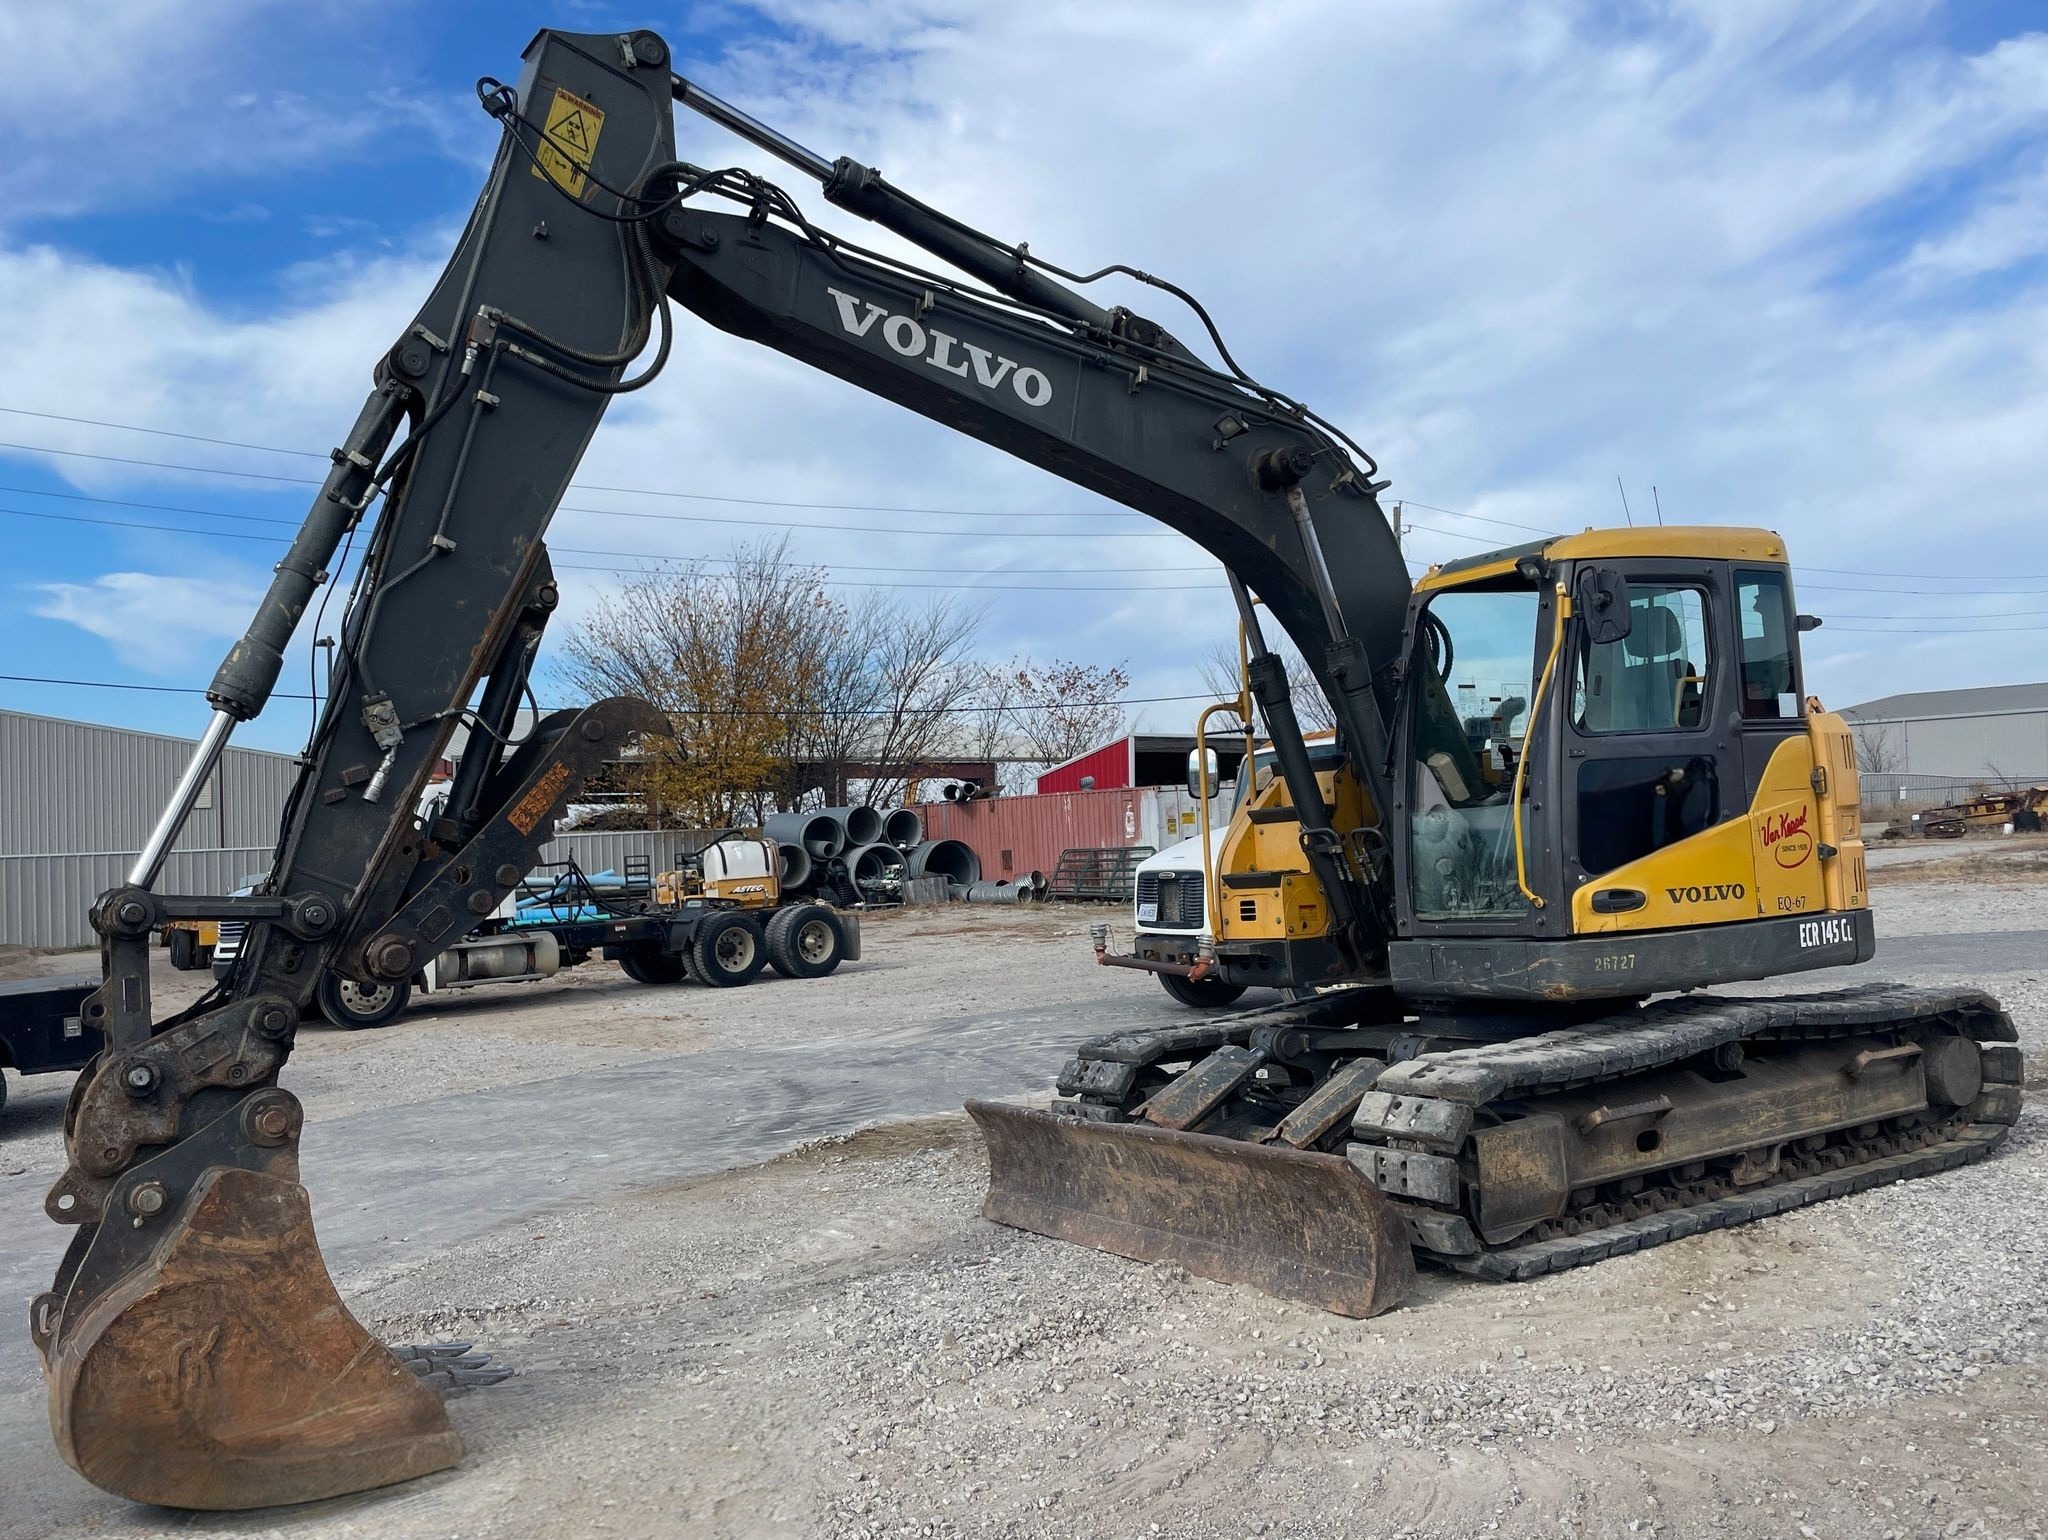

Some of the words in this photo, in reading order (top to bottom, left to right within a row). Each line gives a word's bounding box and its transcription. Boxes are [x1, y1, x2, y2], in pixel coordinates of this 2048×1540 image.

[827, 287, 1053, 407] VOLVO
[1761, 816, 1781, 847] Van
[1782, 845, 1797, 853] SINCE
[732, 884, 764, 894] ASTEC
[1665, 883, 1745, 904] VOLVO
[1777, 895, 1806, 911] EQ-67
[1799, 922, 1820, 948] ECR
[1821, 919, 1840, 945] 145
[1594, 953, 1635, 971] 26727
